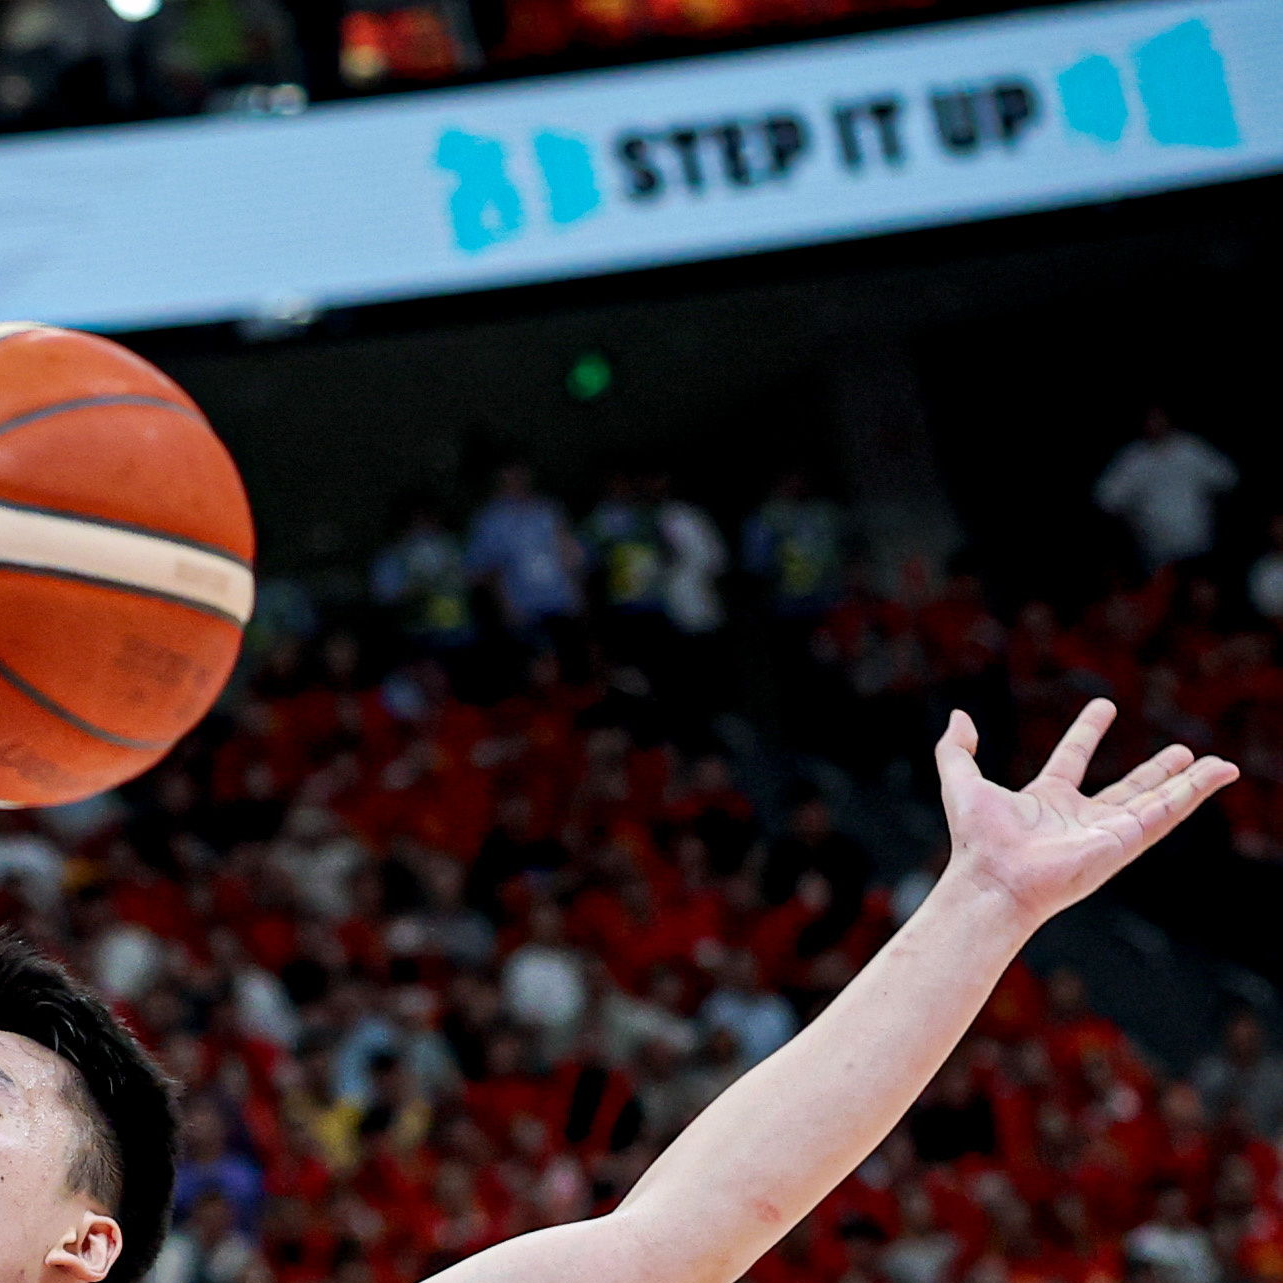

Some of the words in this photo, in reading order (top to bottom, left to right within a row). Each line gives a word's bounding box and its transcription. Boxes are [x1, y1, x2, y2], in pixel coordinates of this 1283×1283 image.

[617, 114, 812, 203] STEP
[833, 98, 903, 170] IT
[927, 78, 1037, 155] UP
